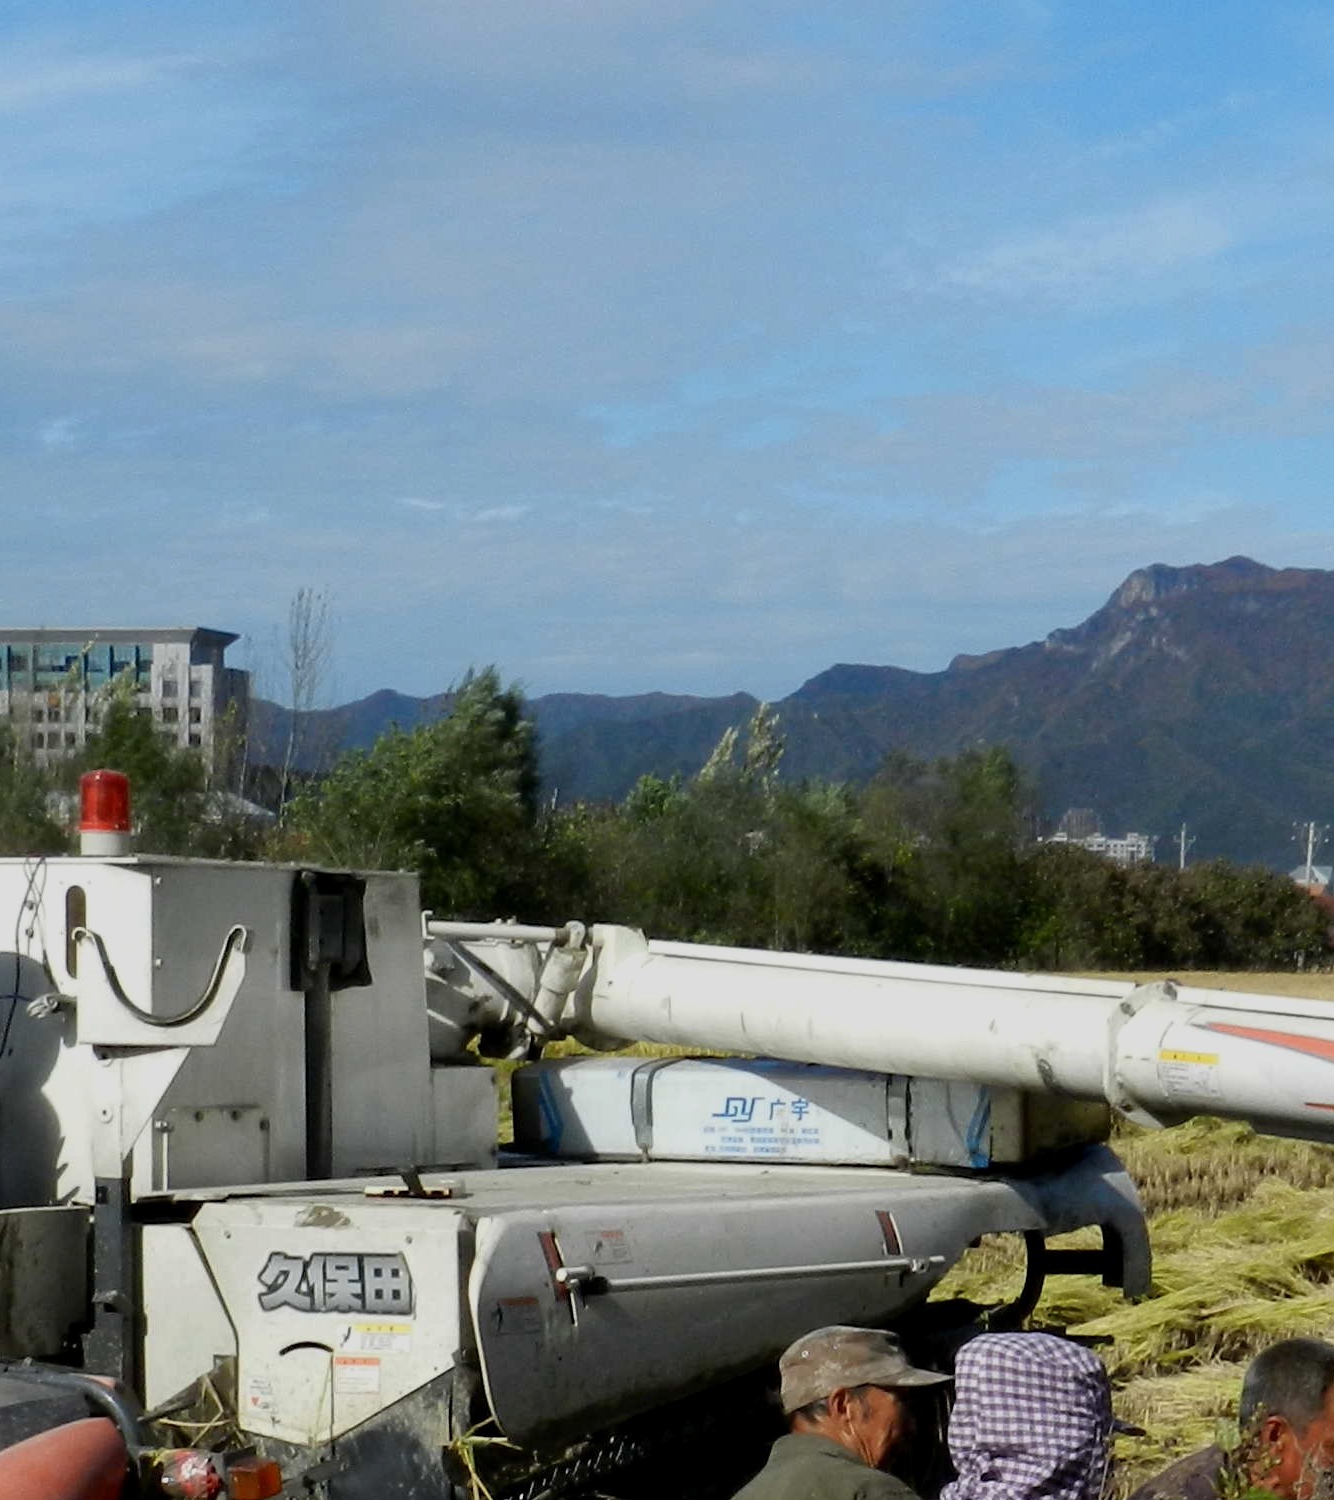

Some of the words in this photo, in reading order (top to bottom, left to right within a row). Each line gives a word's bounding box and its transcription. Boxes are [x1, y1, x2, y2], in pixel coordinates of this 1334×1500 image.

[769, 1098, 810, 1121] 广宇
[258, 1251, 413, 1315] 久保田
